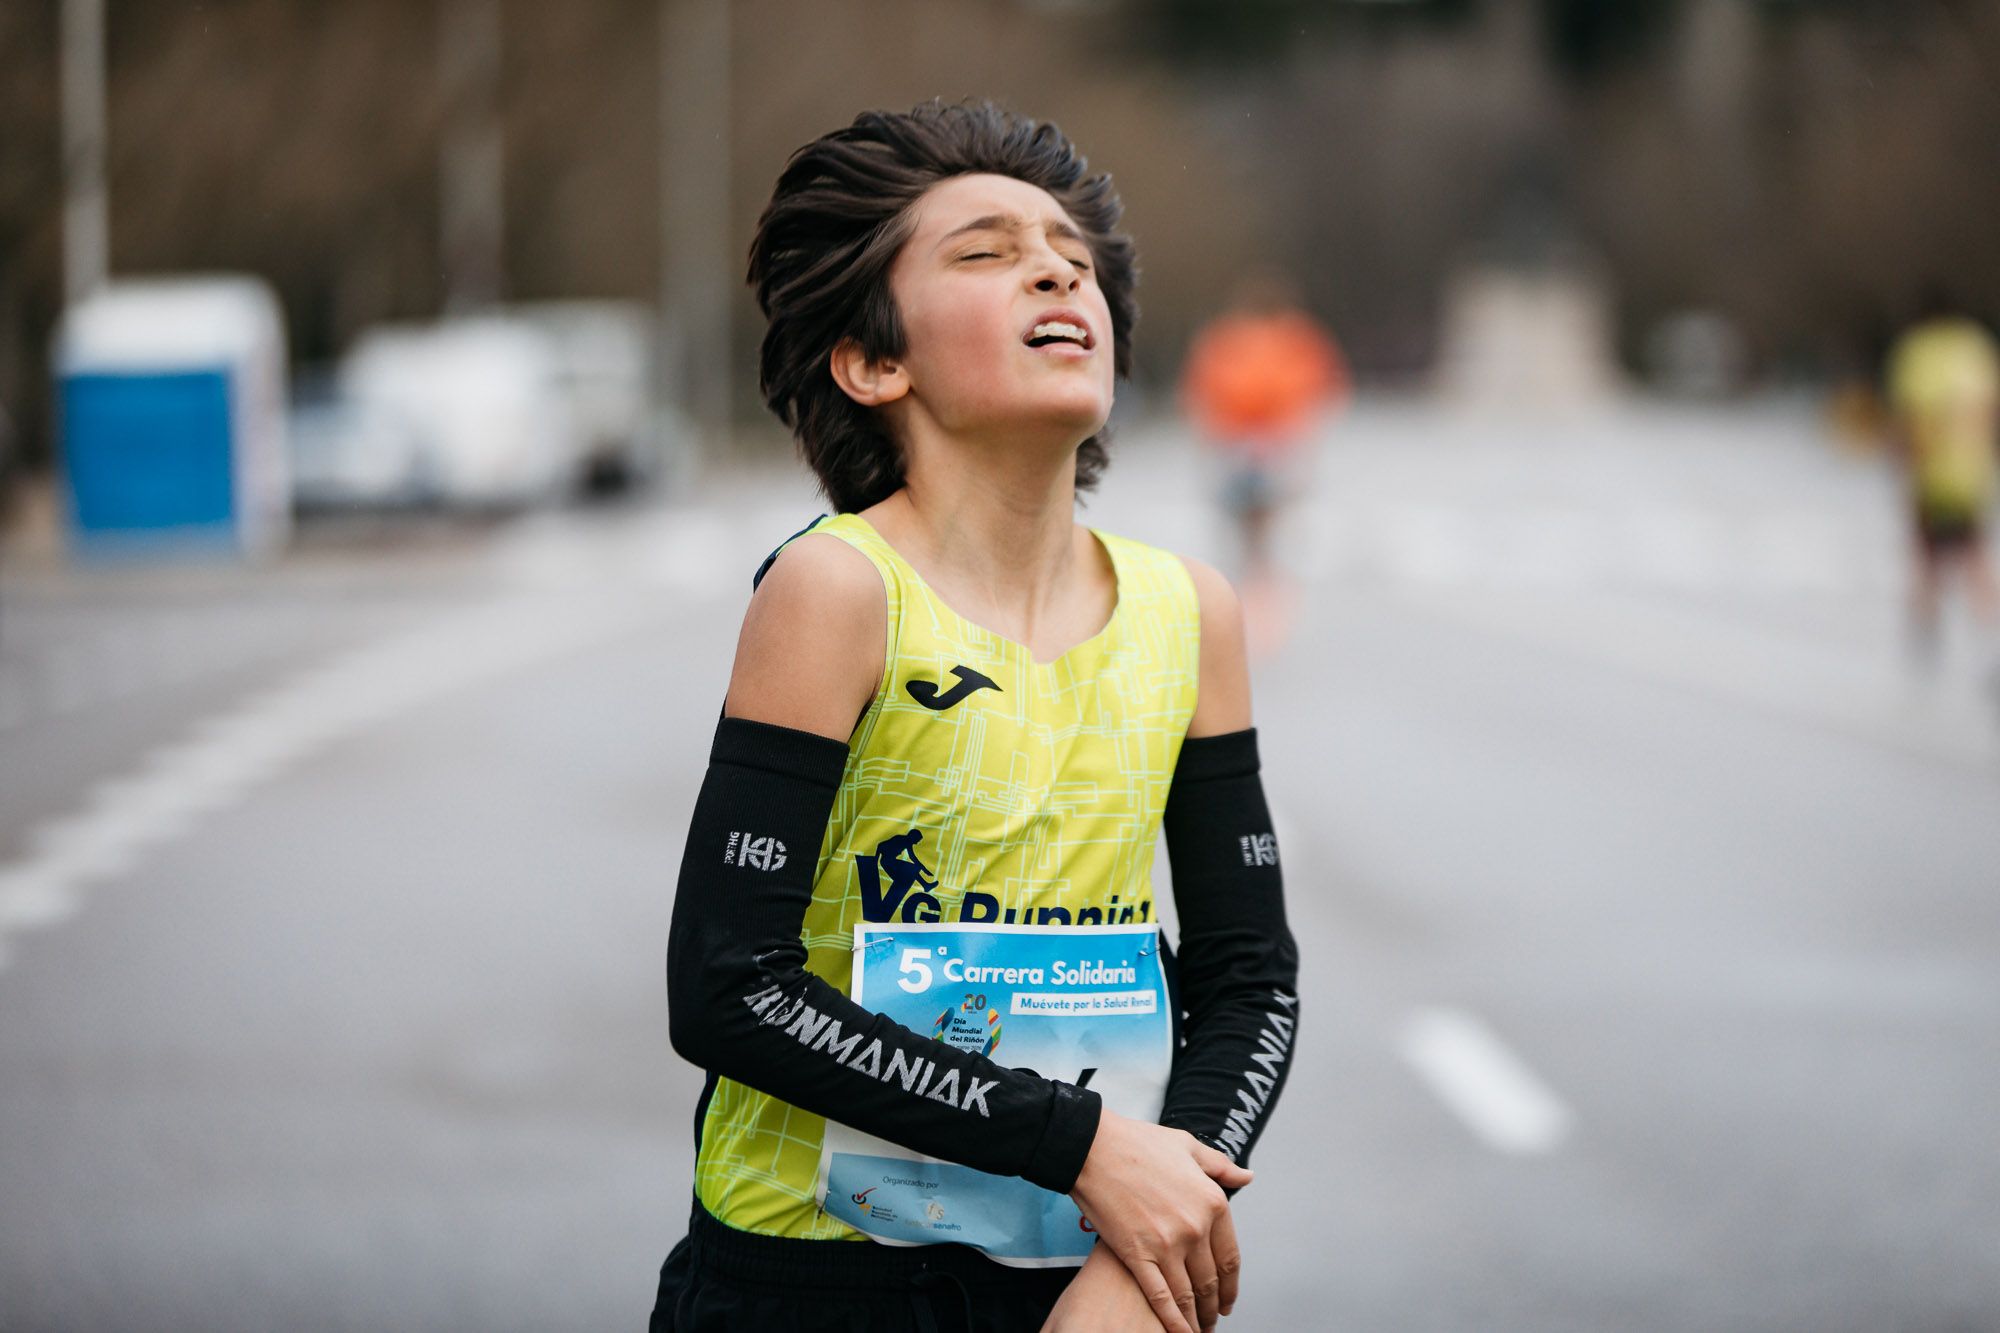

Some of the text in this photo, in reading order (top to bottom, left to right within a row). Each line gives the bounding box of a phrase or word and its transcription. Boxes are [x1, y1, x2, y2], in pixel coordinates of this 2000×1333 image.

[943, 958, 1044, 985] Carrera
[1050, 960, 1136, 985] Solidaria
[1020, 998, 1071, 1009] Muévete
[1073, 1001, 1089, 1012] por
[1104, 997, 1129, 1009] Salud
[951, 1026, 983, 1035] Mundial
[882, 1176, 926, 1187] Organizado
